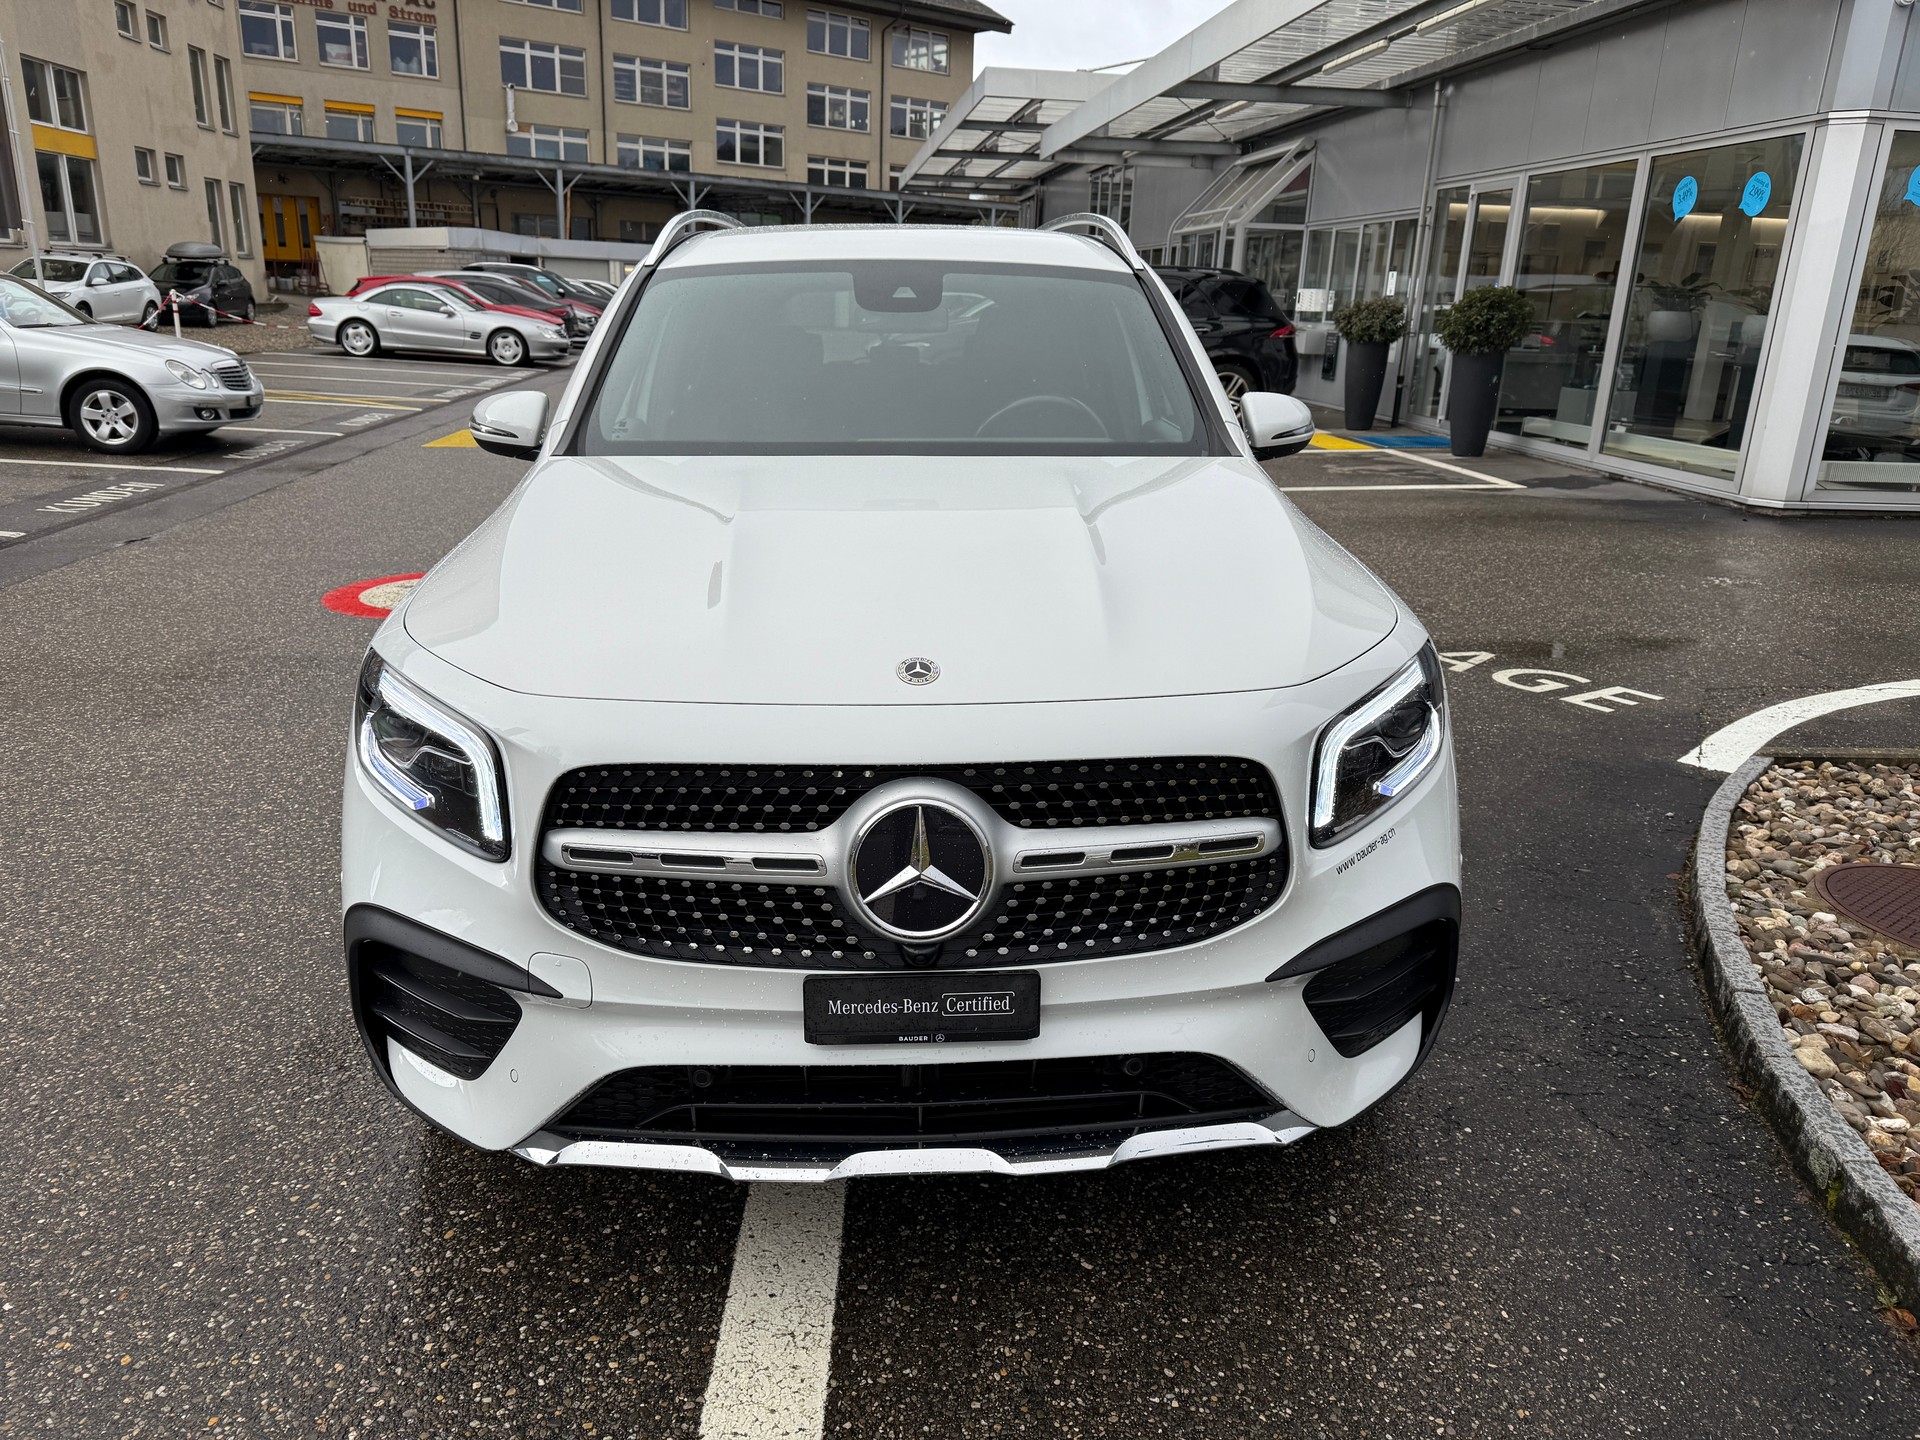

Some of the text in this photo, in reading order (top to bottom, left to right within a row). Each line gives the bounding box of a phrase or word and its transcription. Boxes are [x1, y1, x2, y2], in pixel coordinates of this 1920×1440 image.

[348, 2, 377, 16] und
[389, 6, 437, 25] Strom
[828, 995, 1011, 1015] Mercedes-Benz Certified
